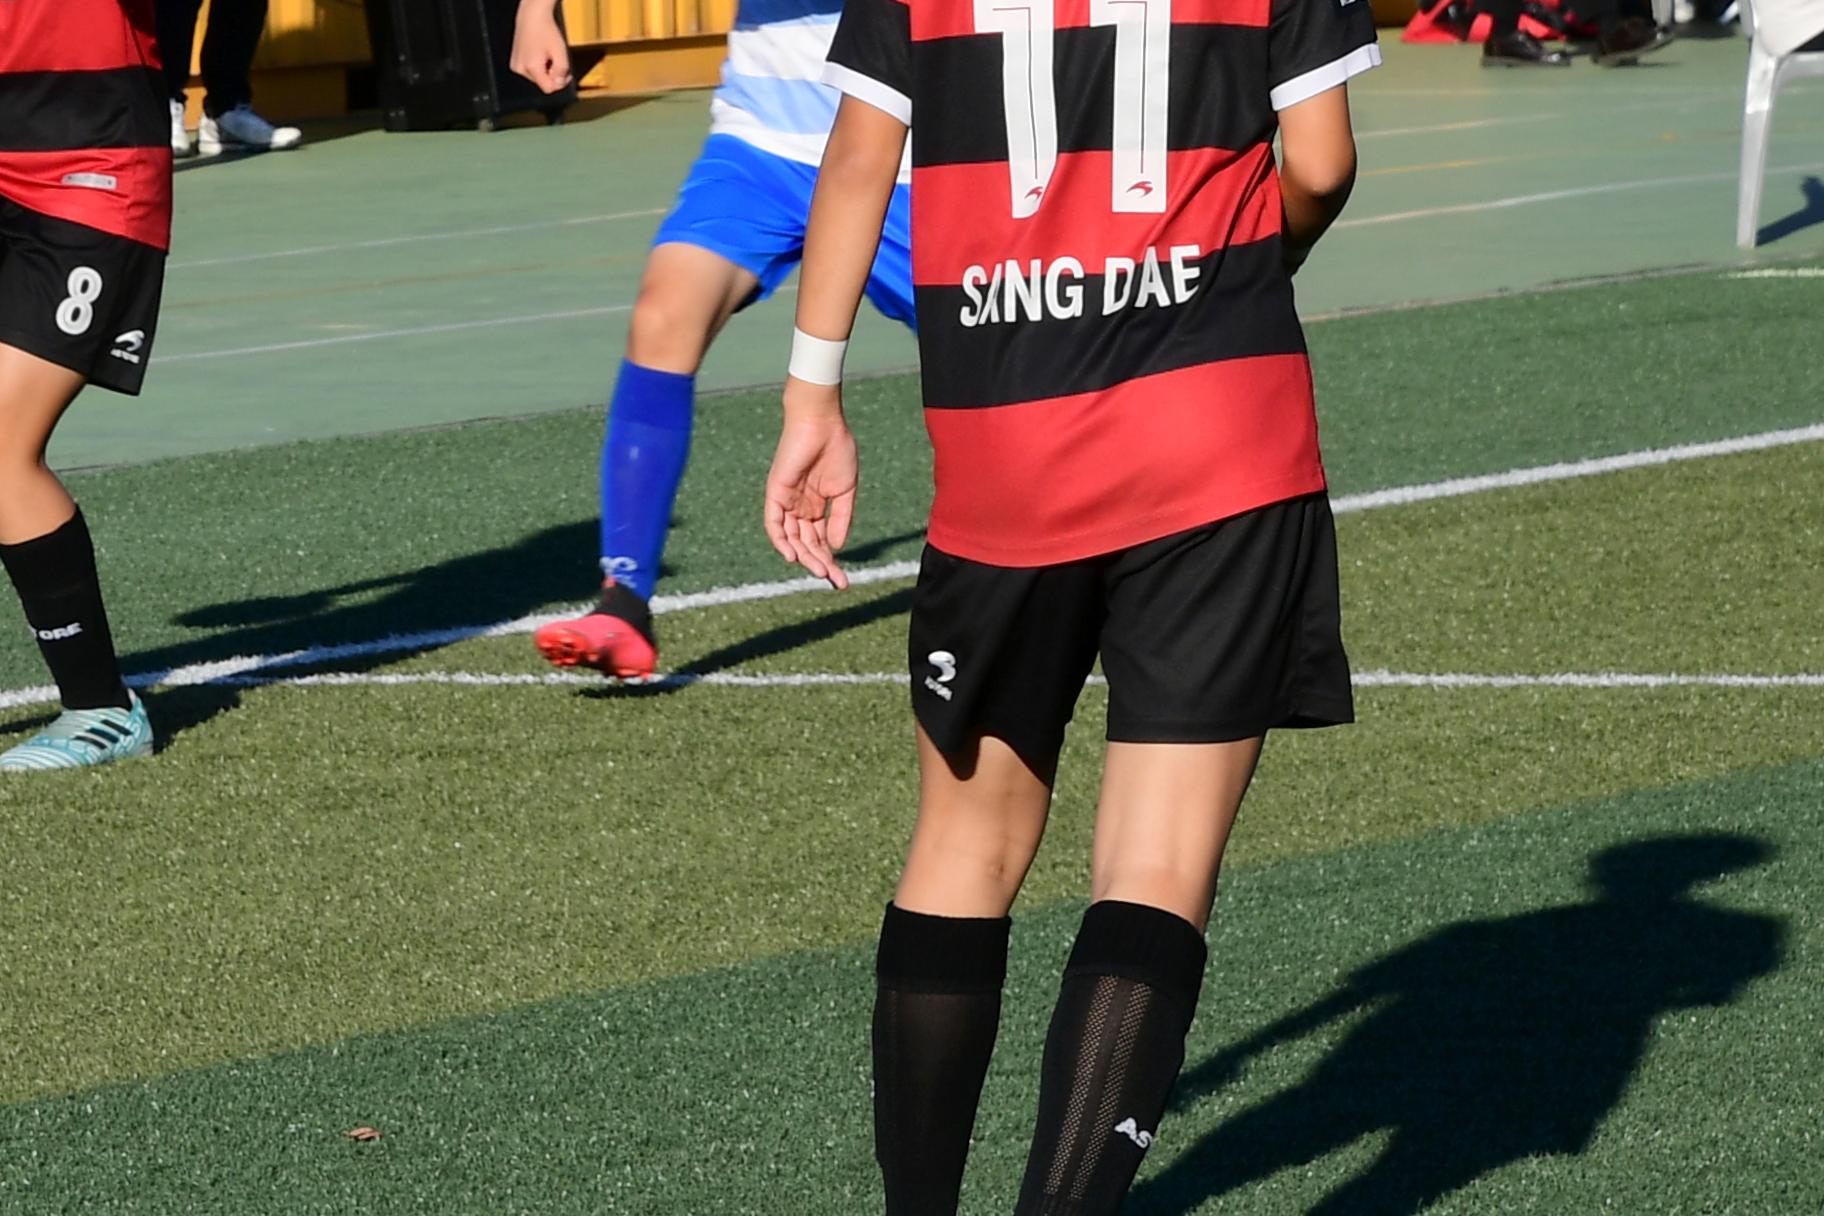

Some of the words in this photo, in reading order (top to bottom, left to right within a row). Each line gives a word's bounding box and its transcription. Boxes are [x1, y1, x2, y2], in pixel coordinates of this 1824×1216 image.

[56, 266, 103, 335] 8
[960, 256, 1085, 327] SANG
[1102, 244, 1201, 316] DAE
